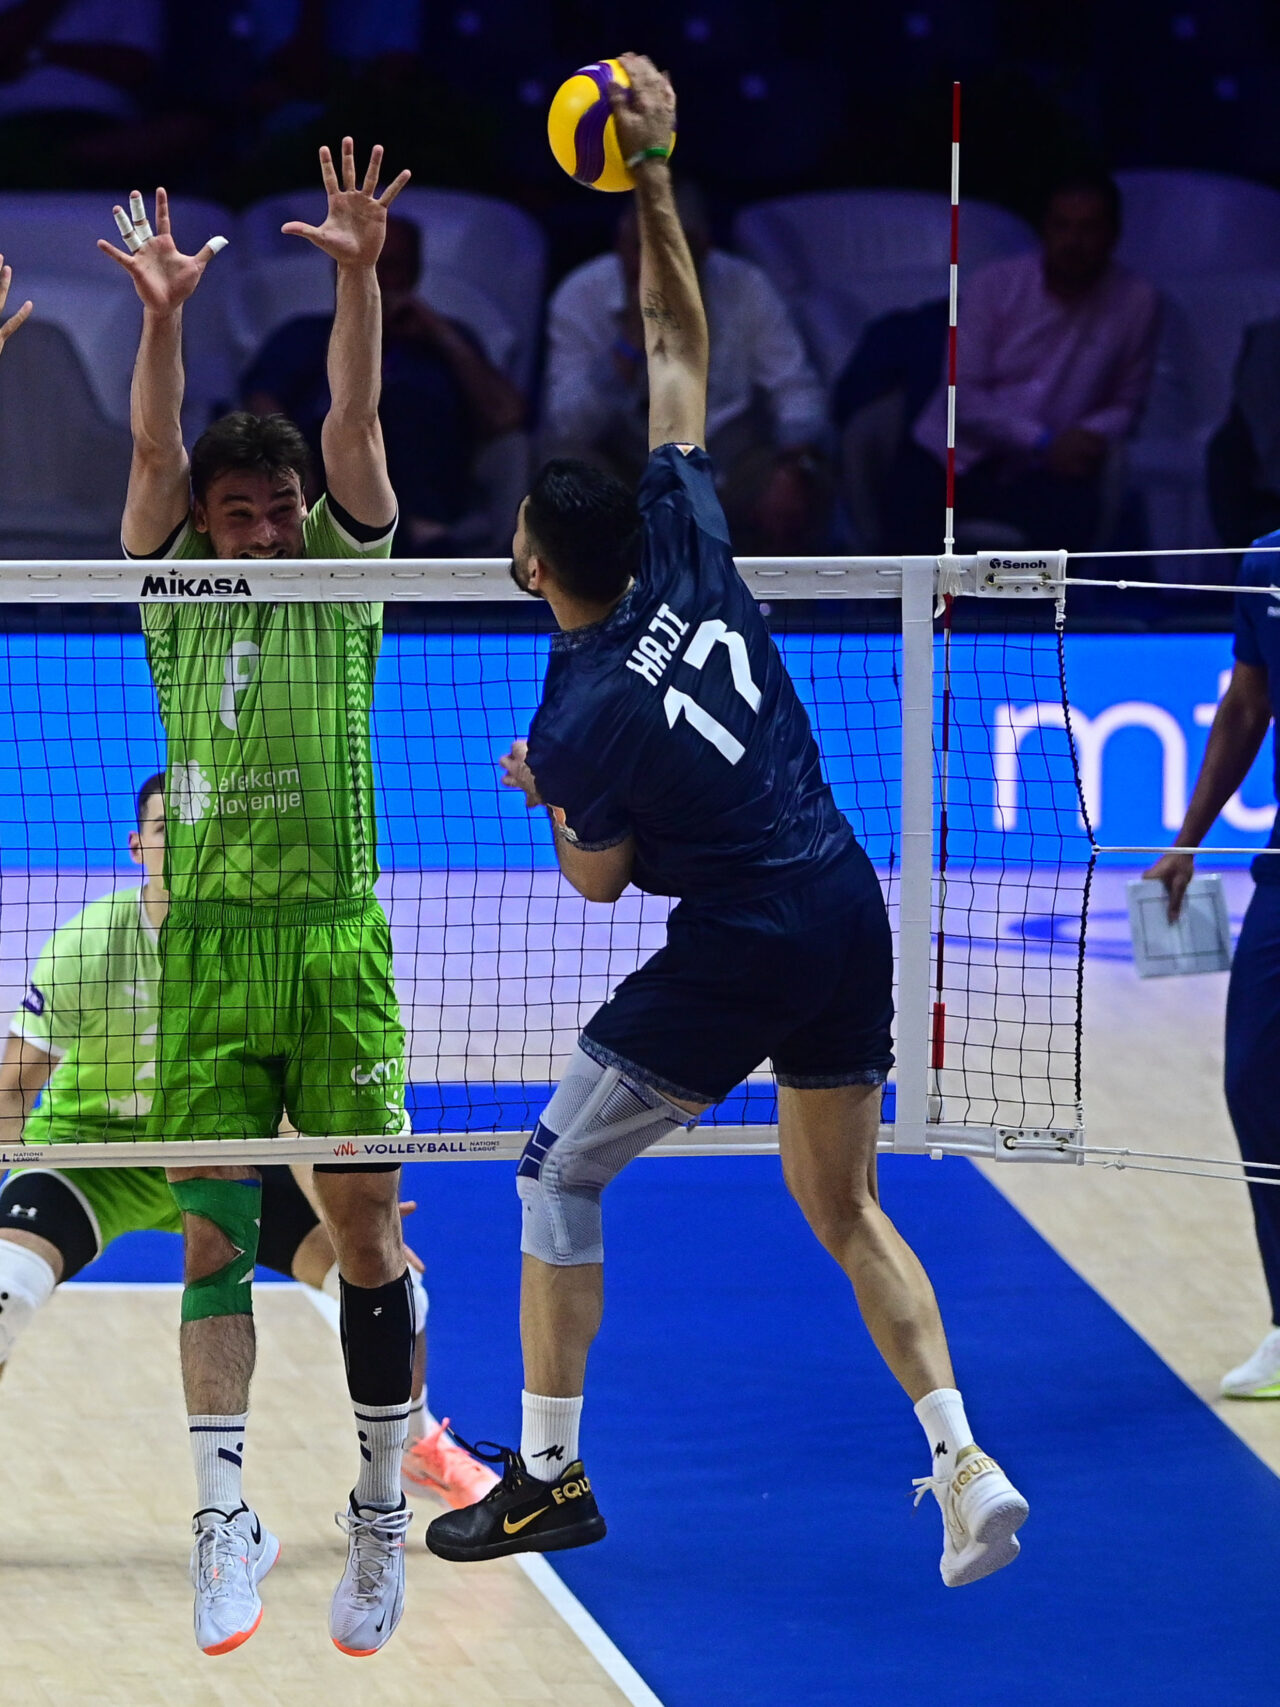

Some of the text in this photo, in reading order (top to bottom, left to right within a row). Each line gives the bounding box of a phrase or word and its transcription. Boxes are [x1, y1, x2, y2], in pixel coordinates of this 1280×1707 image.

[1002, 560, 1047, 569] Senoh
[625, 602, 690, 687] HAJI
[663, 618, 762, 766] 17
[219, 767, 300, 794] elekom
[333, 1141, 359, 1156] VNL
[364, 1142, 467, 1154] VOLLEYBALL
